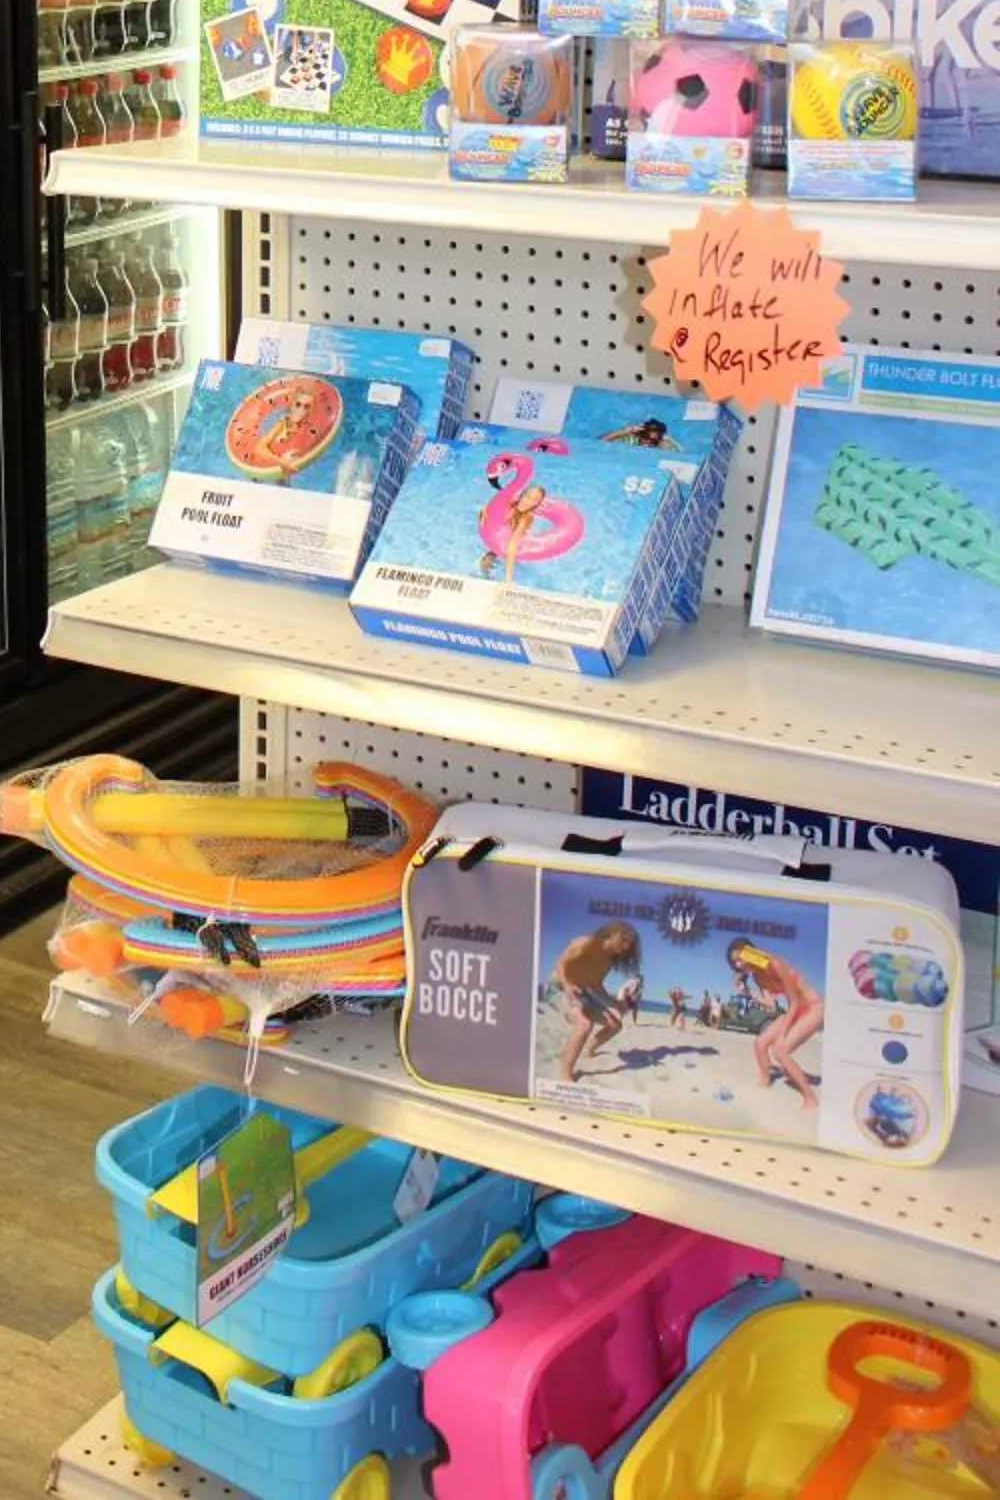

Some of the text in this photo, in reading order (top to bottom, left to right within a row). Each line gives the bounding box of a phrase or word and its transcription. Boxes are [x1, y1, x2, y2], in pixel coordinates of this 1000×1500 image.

[699, 228, 822, 283] We will
[867, 361, 937, 382] THUNDER
[939, 368, 979, 388] BOLT
[201, 490, 235, 507] FRUIT
[181, 507, 244, 529] POOL FLOAT
[375, 567, 465, 593] FLAMINGO POOL
[383, 620, 449, 642] FLAMINGO
[618, 771, 943, 860] Ladderball St
[421, 915, 500, 945] Franklin
[429, 949, 492, 988] SOFT
[419, 983, 499, 1026] BOCCE
[209, 1271, 236, 1301] GIANT
